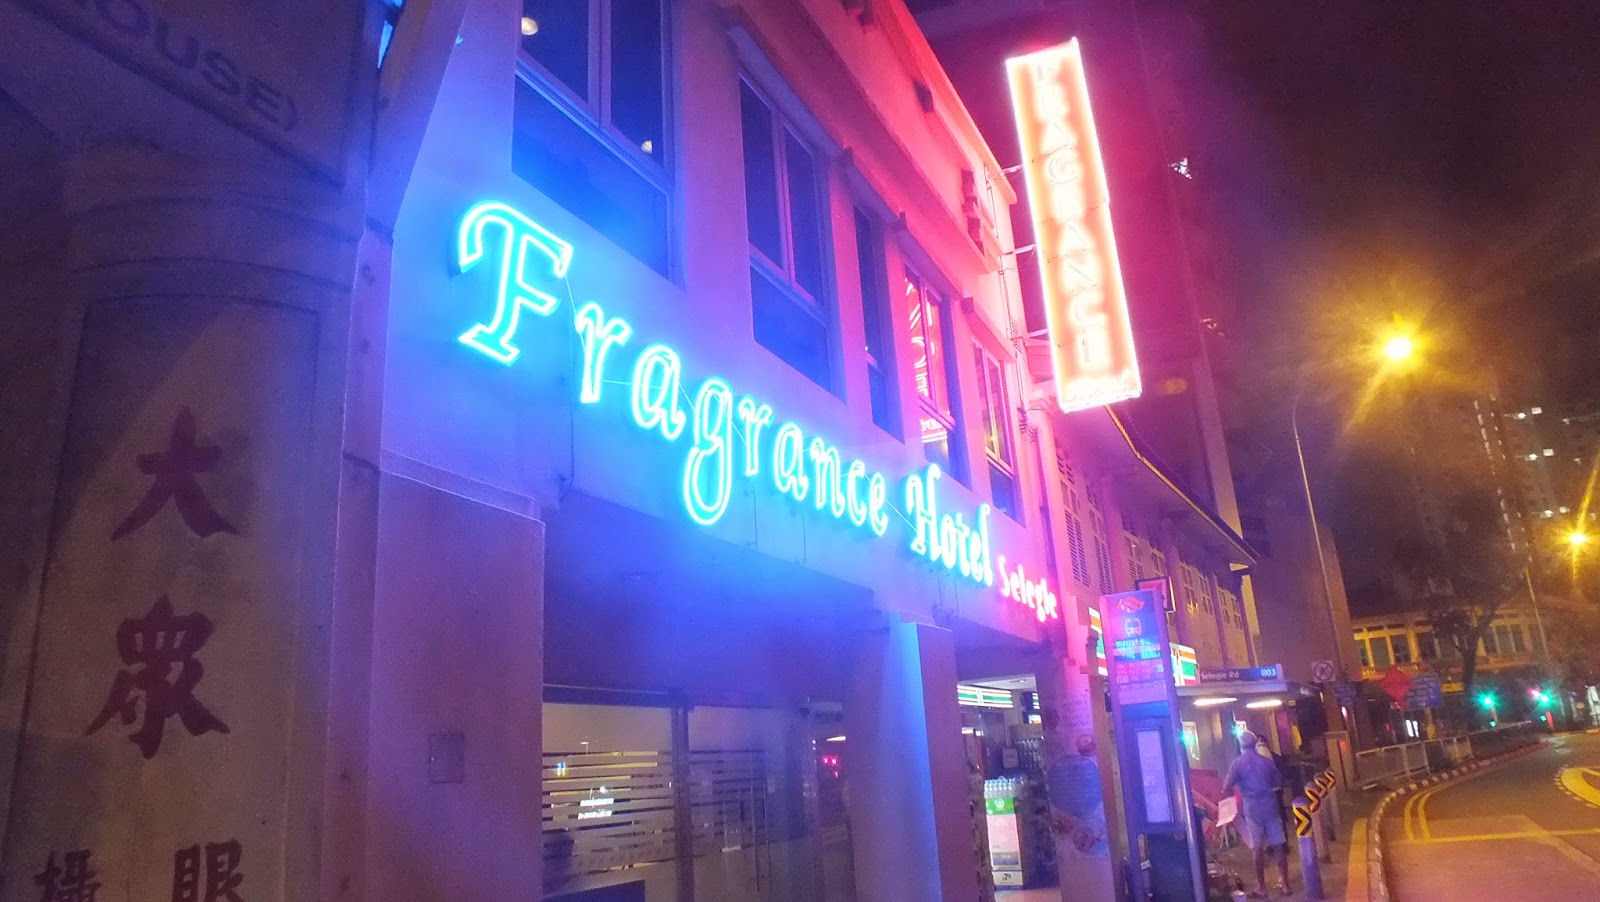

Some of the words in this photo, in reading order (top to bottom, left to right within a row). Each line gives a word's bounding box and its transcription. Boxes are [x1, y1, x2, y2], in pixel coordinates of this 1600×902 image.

[457, 200, 889, 537] Fragrance
[905, 462, 993, 587] Hotel
[998, 554, 1059, 622] Selegie
[1229, 670, 1240, 678] Rd
